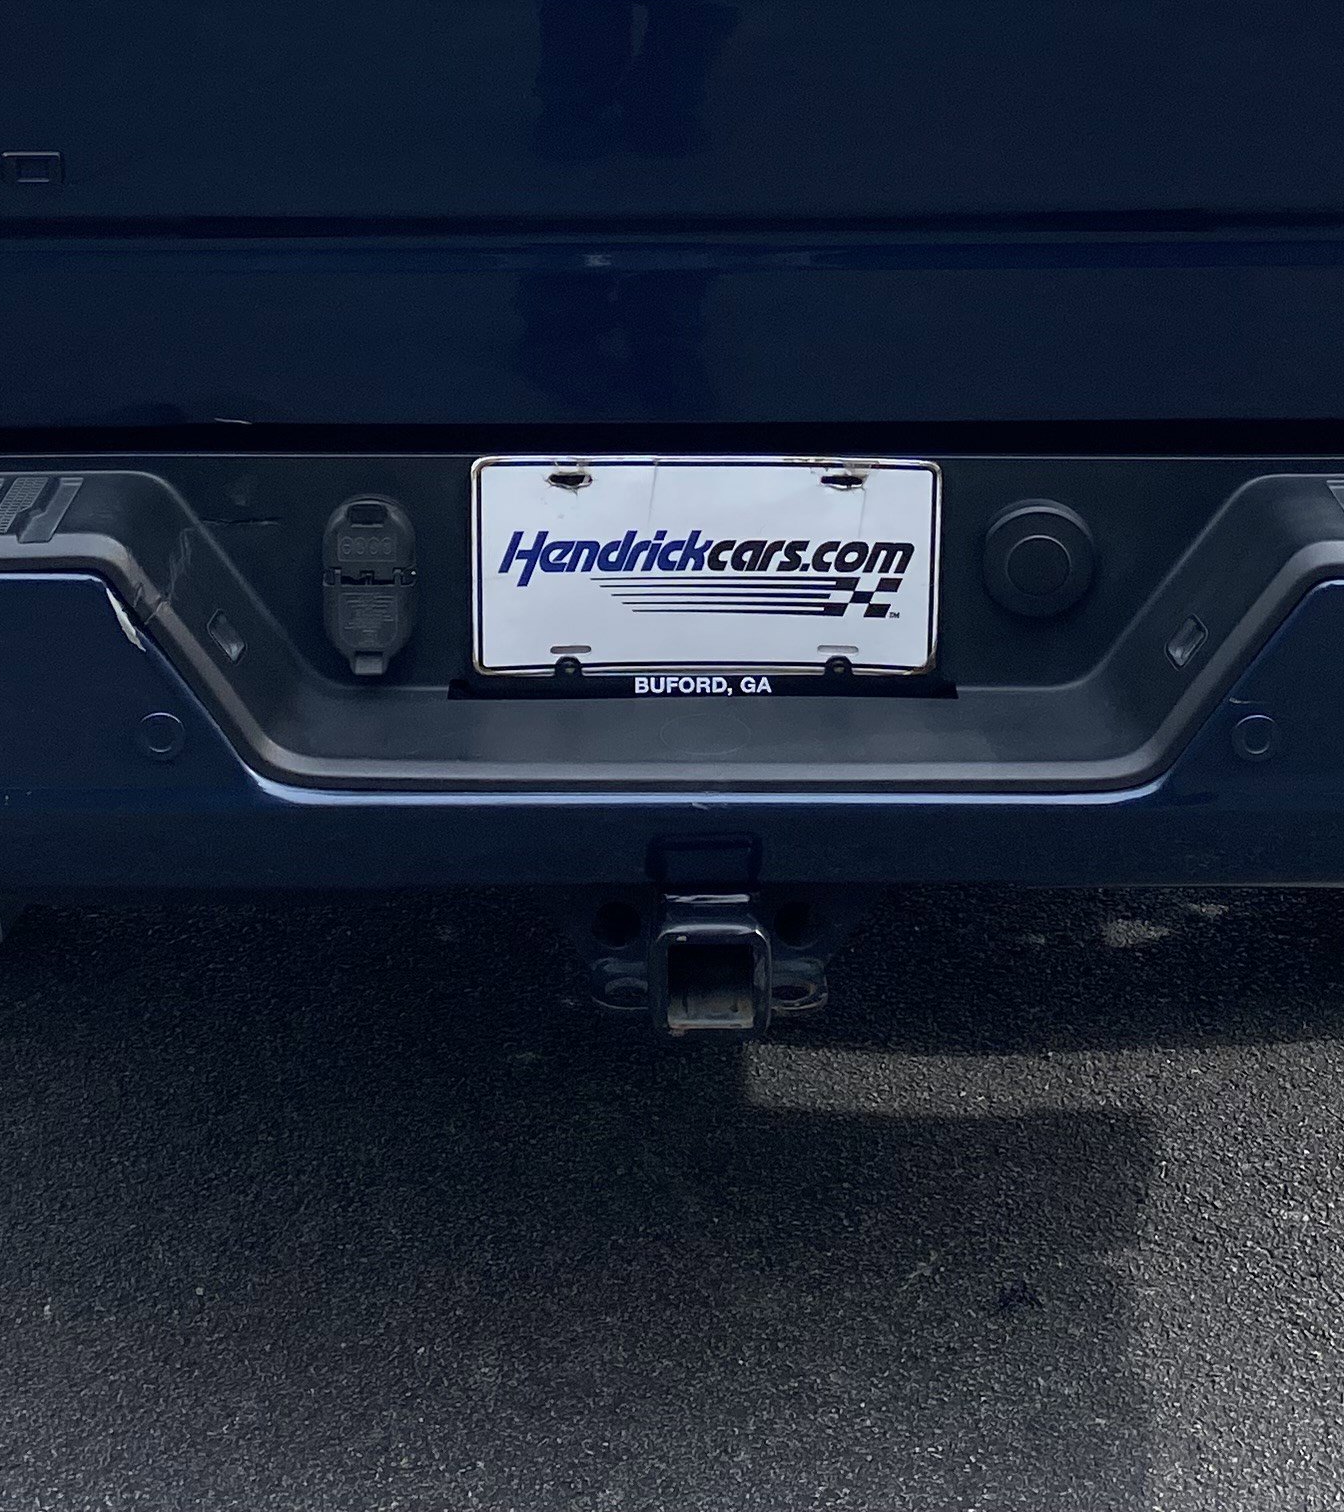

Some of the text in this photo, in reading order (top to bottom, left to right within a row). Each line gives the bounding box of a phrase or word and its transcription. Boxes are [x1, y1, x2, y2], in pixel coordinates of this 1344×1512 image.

[497, 529, 916, 588] Hendrickcars.com
[634, 676, 773, 696] BUFORD, GA
